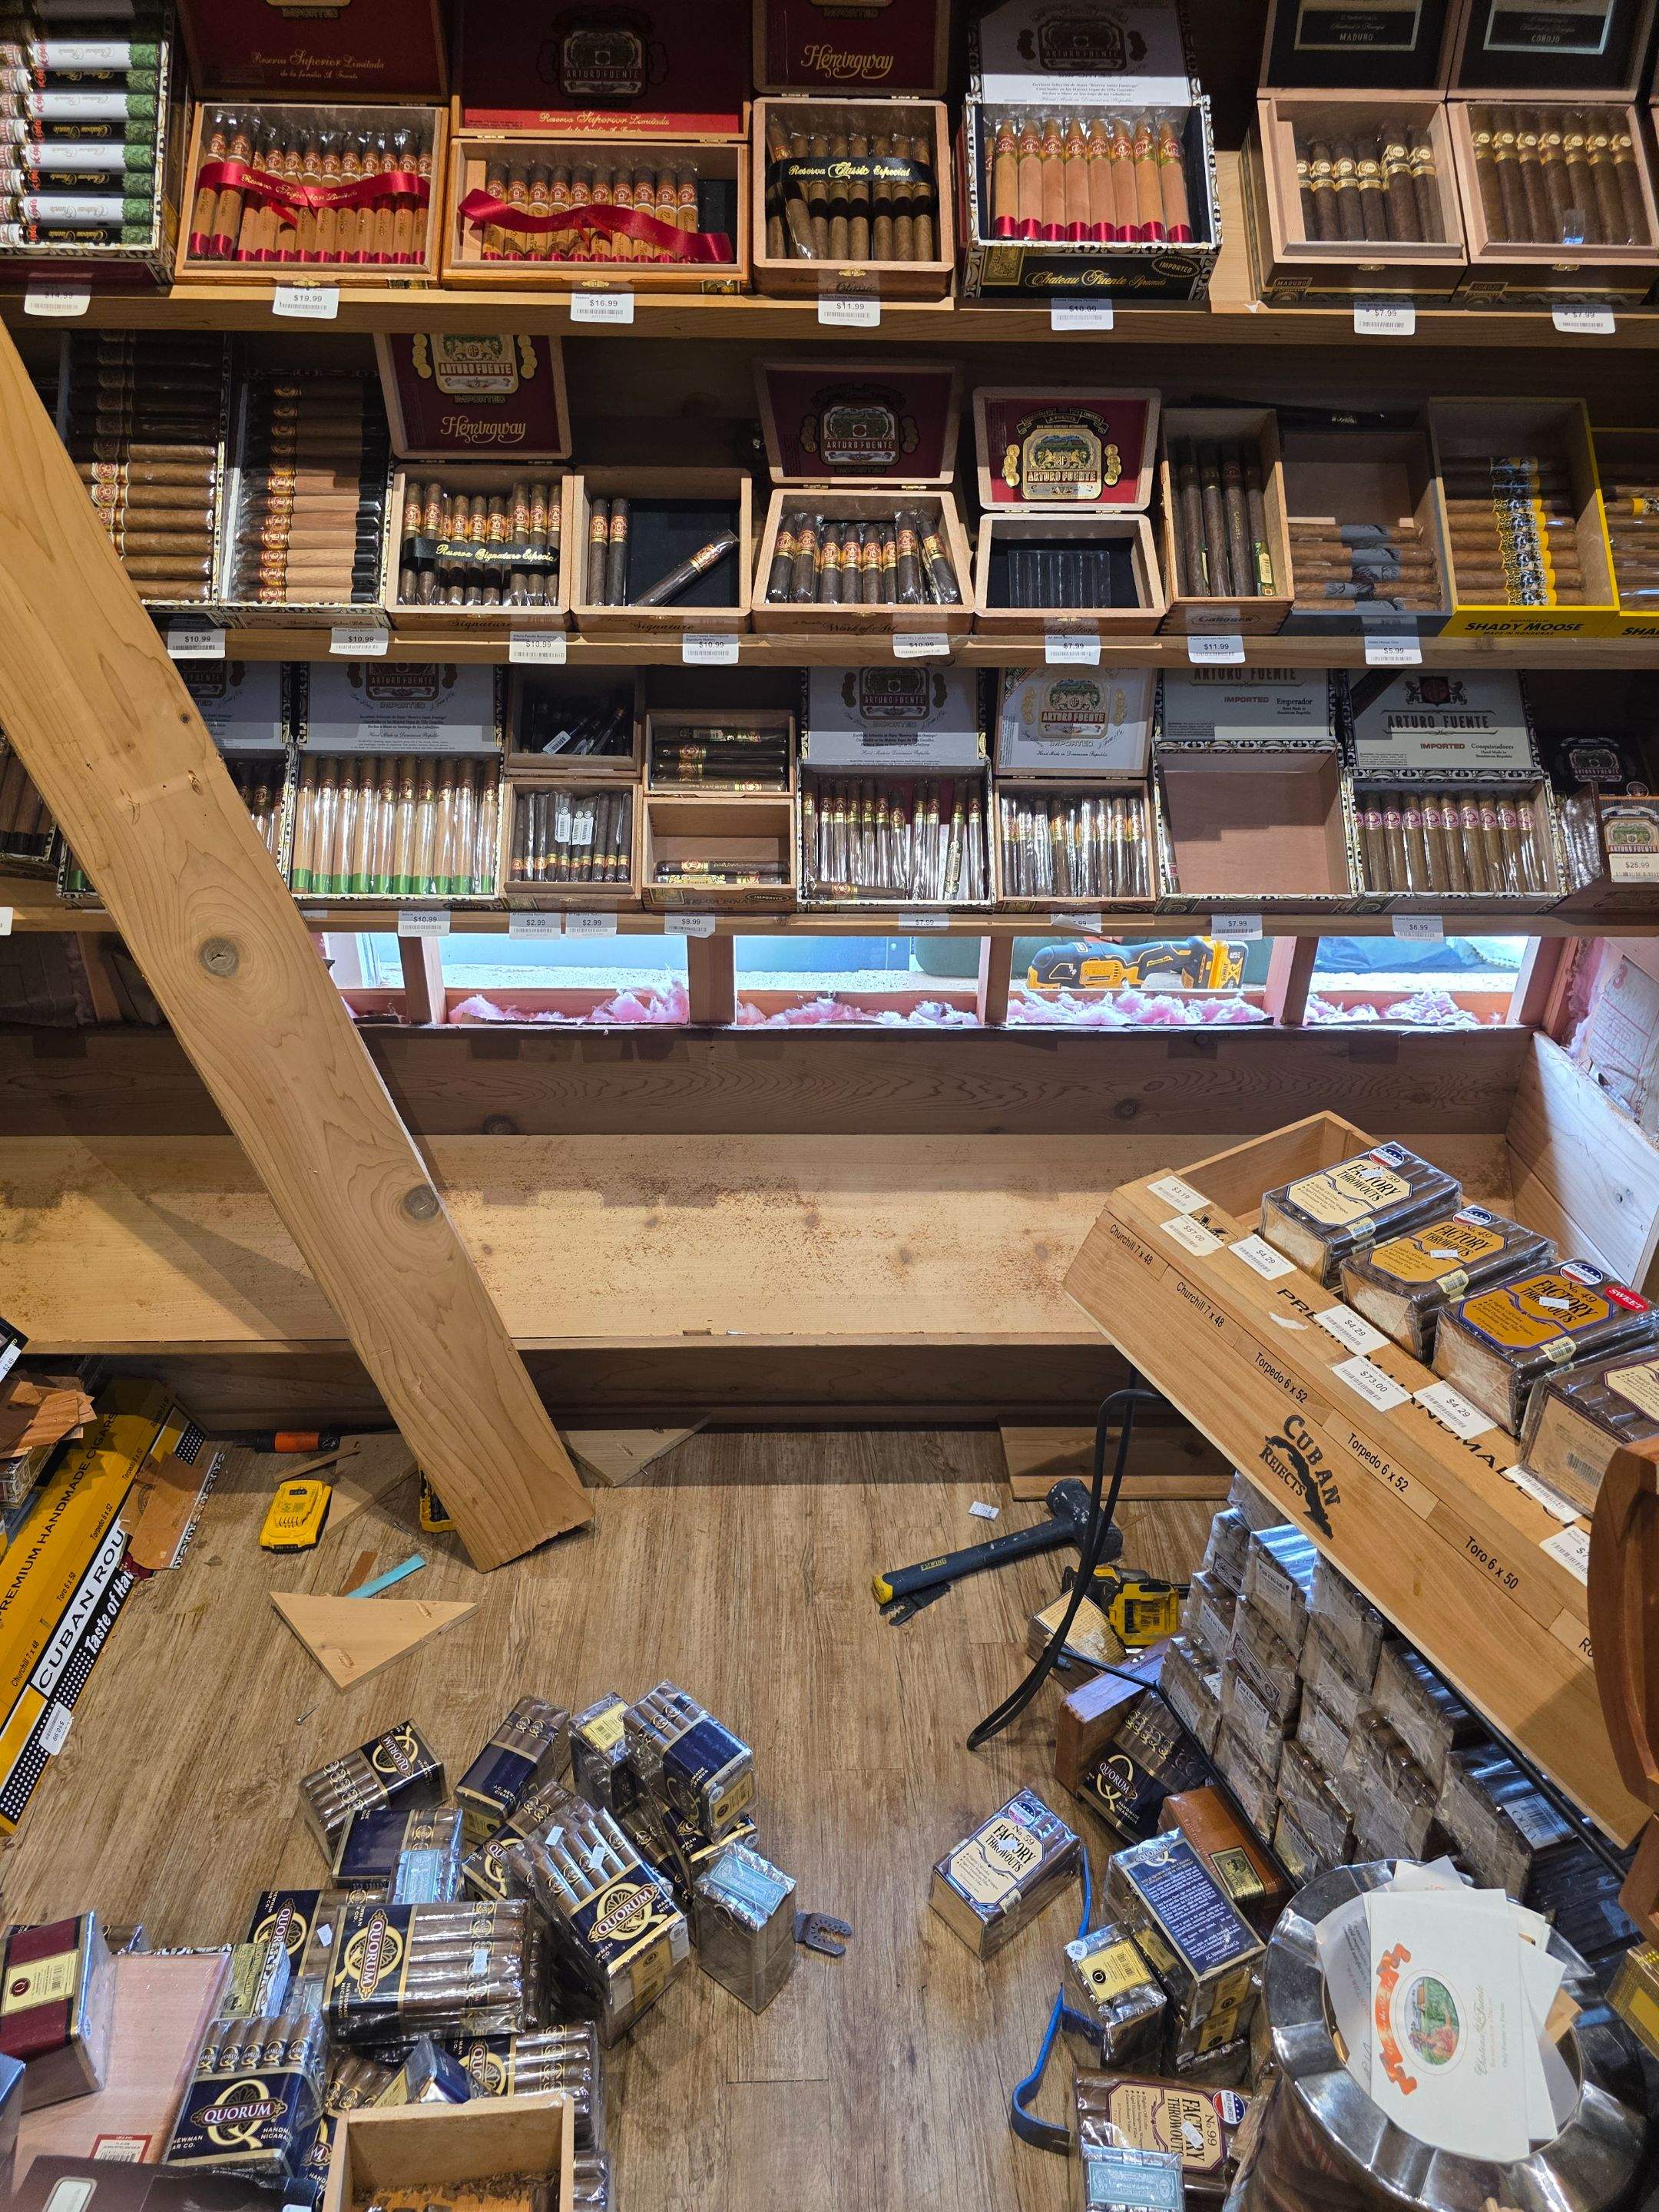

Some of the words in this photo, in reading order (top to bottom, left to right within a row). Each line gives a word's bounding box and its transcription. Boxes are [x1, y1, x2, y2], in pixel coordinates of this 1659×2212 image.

[1339, 33, 1374, 41] MADURO
[800, 44, 894, 79] Hemingway
[828, 162, 870, 179] Classic
[1158, 261, 1193, 273] IMPORTED
[1025, 270, 1080, 288] Chateau
[1081, 270, 1128, 286] Fuente
[440, 364, 475, 374] ARTURO
[477, 363, 512, 374] FUENTE
[440, 416, 526, 444] Hemingway
[826, 441, 858, 449] ARTURO
[861, 441, 893, 449] FUENTE
[1028, 471, 1061, 482] ARTURO
[1062, 471, 1096, 482] FUENTE
[1465, 622, 1524, 632] SHADY
[1525, 623, 1584, 631] MOOSE
[1194, 667, 1242, 680] ARTURO
[1250, 667, 1297, 680] FUENTE
[865, 695, 893, 704] ARTURO
[895, 695, 926, 704] FUENTE
[1277, 697, 1313, 706] Emperador
[1042, 712, 1072, 722] ARTURO
[1074, 712, 1105, 722] FUENTE
[1387, 715, 1435, 729] ARTURO
[1443, 715, 1489, 729] FUENTE
[1471, 743, 1514, 751] Conquistadores
[1171, 1186, 1190, 1200] $3.19
[1336, 1170, 1384, 1202] THROWOUTS
[1183, 1224, 1205, 1242] $57.00
[1433, 1224, 1493, 1251] FACTORY
[1475, 1230, 1493, 1239] 49
[1110, 1224, 1136, 1250] Churchill
[1143, 1253, 1154, 1266] 48
[1256, 1248, 1276, 1265] $4.29
[1176, 1281, 1205, 1311] Churchill
[1214, 1316, 1224, 1328] 48
[1580, 1292, 1598, 1303] 49
[1608, 1288, 1644, 1310] SWEET
[1344, 1319, 1366, 1337] $4.29
[1254, 1352, 1284, 1383] Torpedo
[1295, 1389, 1308, 1404] 52
[1359, 1369, 1388, 1393] $73.00
[1445, 1397, 1471, 1418] $4.29
[1259, 1444, 1306, 1497] REJECTS
[1283, 1414, 1341, 1506] CUBAN
[1346, 1432, 1381, 1469] Torpedo
[1380, 1464, 1389, 1475] 6
[1387, 1472, 1395, 1482] x
[1395, 1476, 1409, 1492] 52
[39, 1461, 91, 1545] HANDMADE
[86, 1411, 118, 1461] CIGARS
[90, 1517, 107, 1541] Torpedo
[921, 1558, 947, 1570] ESTWING
[1465, 1536, 1488, 1563] Toro
[1487, 1558, 1497, 1570] 6
[1495, 1567, 1502, 1578] x
[1502, 1572, 1519, 1590] 50
[56, 1588, 67, 1603] Toro
[69, 1571, 77, 1581] 50
[84, 1614, 111, 1655] Taste
[108, 1591, 122, 1619] of
[39, 1589, 98, 1690] CUBAN
[11, 1656, 29, 1687] Churchill
[32, 1639, 40, 1651] 48
[51, 1720, 66, 1742] $10.99
[382, 1735, 409, 1772] QUORUM
[1099, 1761, 1131, 1794] QUORUM
[1118, 1800, 1141, 1820] HANDMADE
[1012, 1825, 1023, 1837] No.
[1022, 1834, 1035, 1846] 59
[597, 1888, 653, 1936] QUORUM
[363, 1921, 382, 1985] QUORUM
[204, 2103, 271, 2124] QUORUM
[1206, 2131, 1217, 2146] 99
